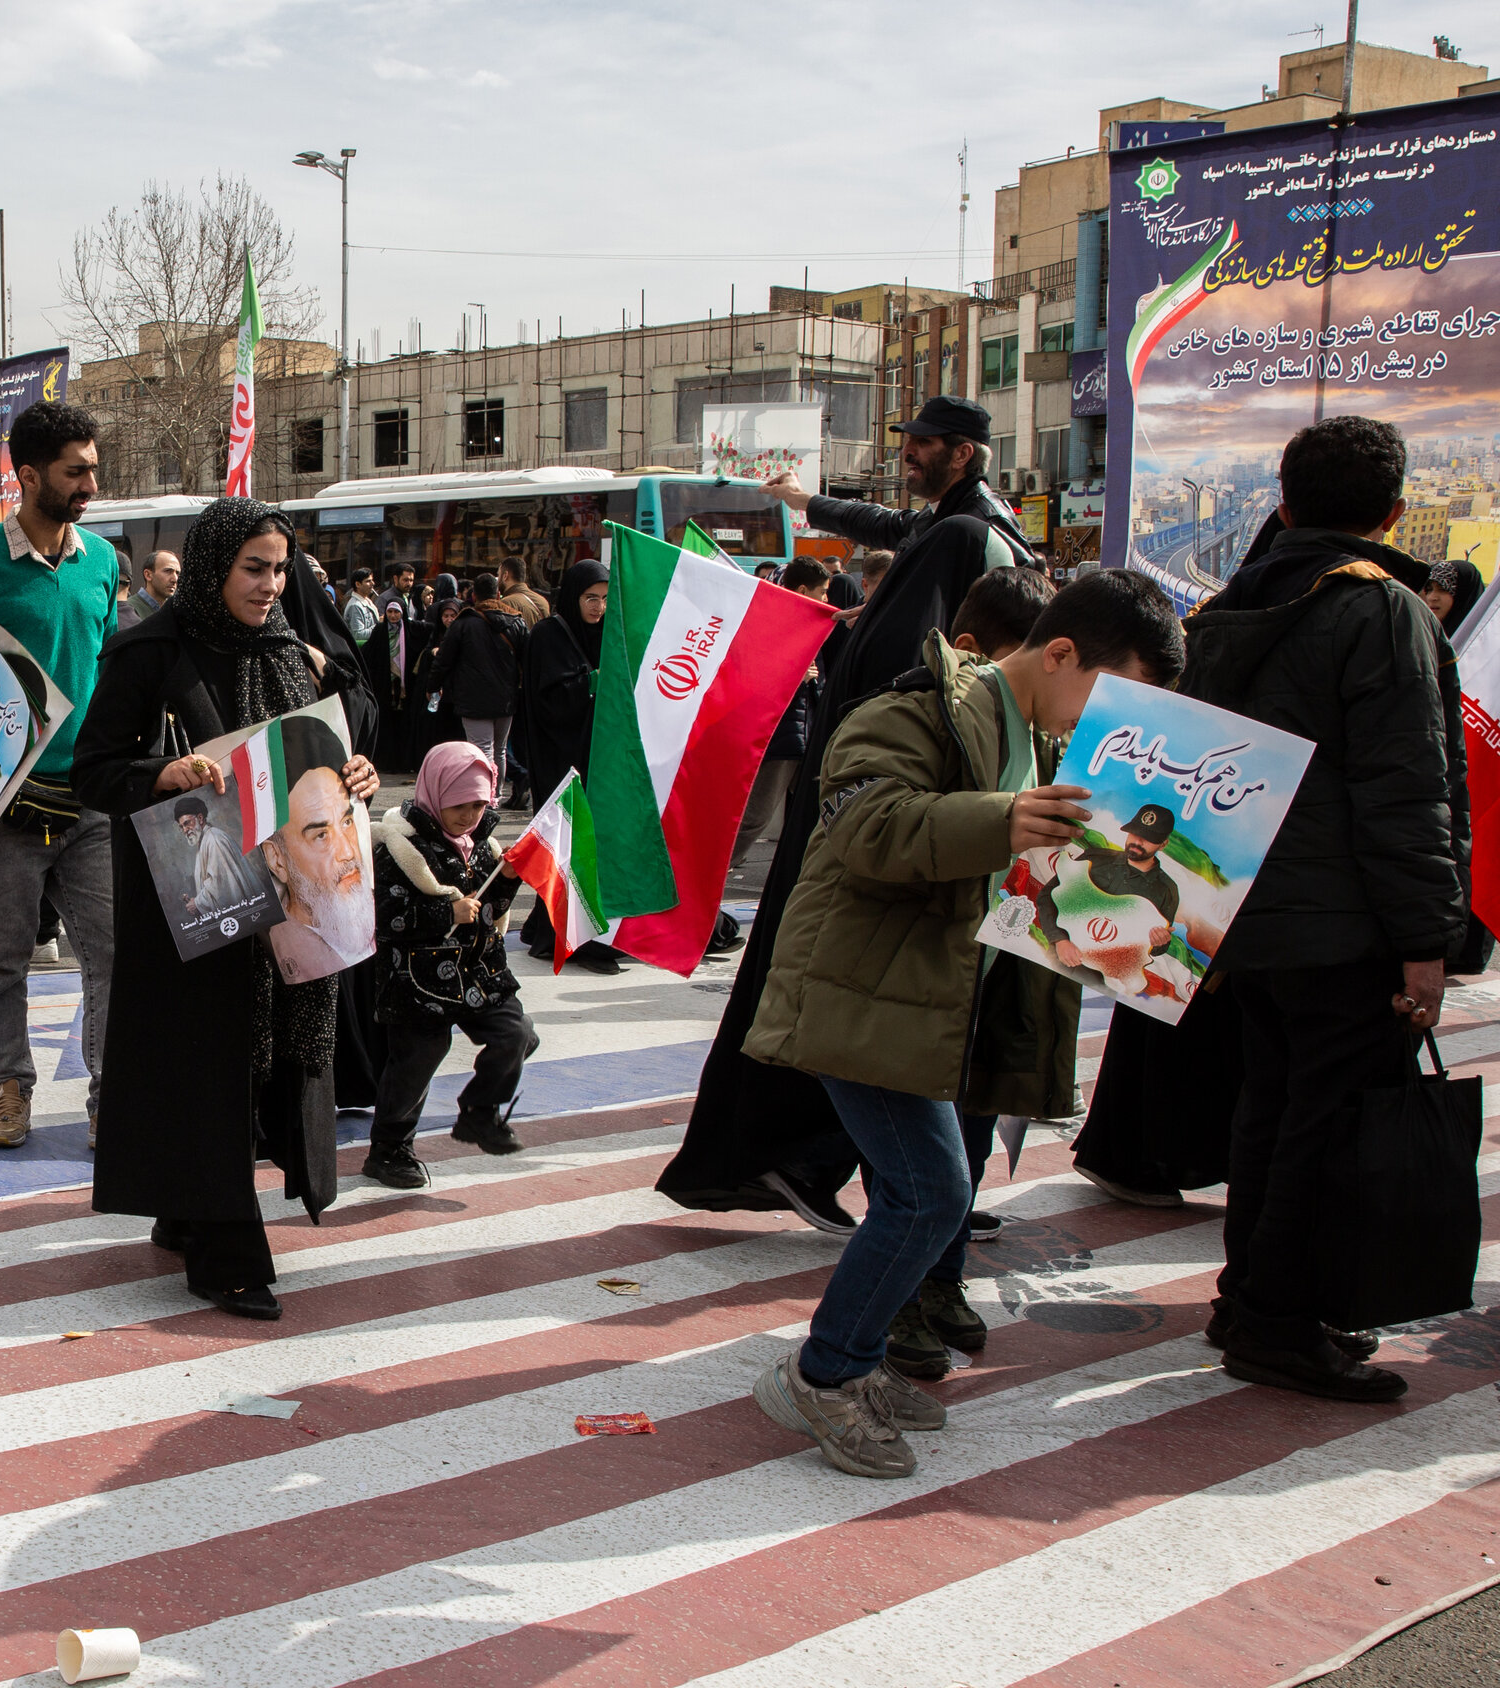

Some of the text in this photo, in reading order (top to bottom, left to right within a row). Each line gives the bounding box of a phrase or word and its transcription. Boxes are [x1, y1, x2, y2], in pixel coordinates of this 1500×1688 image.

[1317, 146, 1369, 168] سازندگی
[1369, 137, 1421, 158] قرارگاه
[1421, 130, 1497, 154] دستاوردهای
[1202, 166, 1225, 182] سپاه
[1282, 152, 1318, 173] خاتم
[1244, 162, 1435, 200] در توسعه عمران و آبادانی کشور
[1305, 228, 1331, 284] فتح
[1343, 240, 1385, 270] ملت
[1384, 242, 1424, 267] اراده
[1424, 209, 1476, 270] تحقق
[1204, 240, 1258, 290] سازندگی
[1256, 250, 1286, 286] های
[1285, 243, 1312, 277] قله
[1168, 306, 1500, 358] جرای تقاطع شهری و سازه های خاص
[1208, 349, 1447, 390] در بیش از ۱۵ استان کشور
[681, 627, 702, 653] I.R.
[695, 615, 724, 658] IRAN
[1093, 729, 1265, 815] من هم یک پاسدارم
